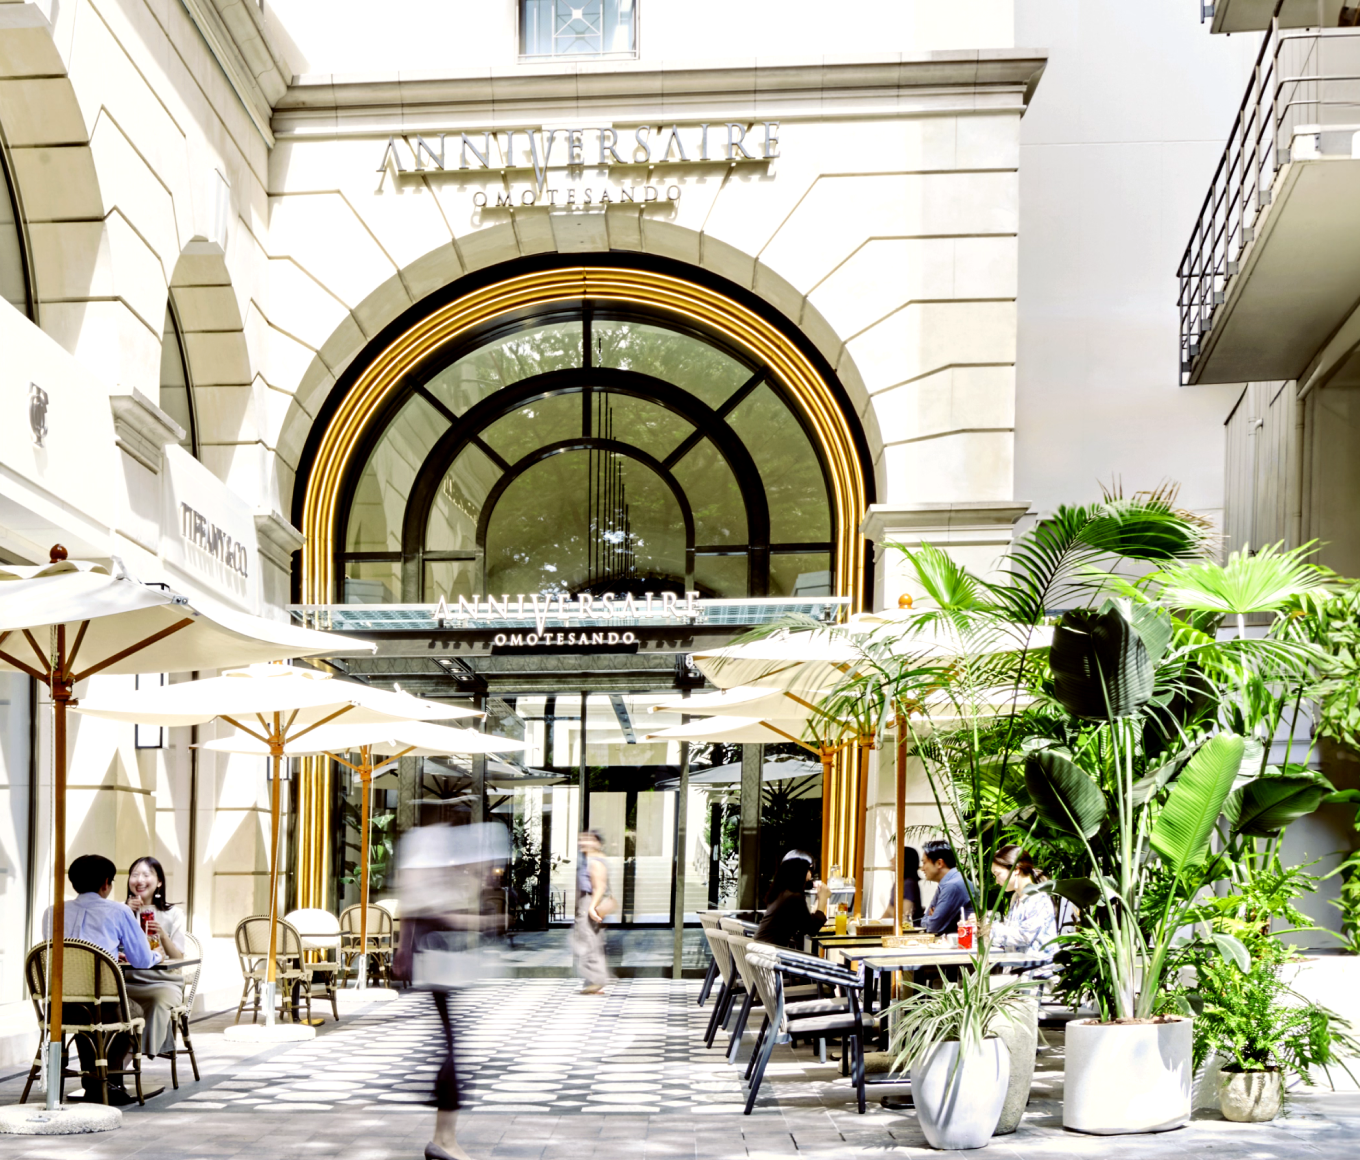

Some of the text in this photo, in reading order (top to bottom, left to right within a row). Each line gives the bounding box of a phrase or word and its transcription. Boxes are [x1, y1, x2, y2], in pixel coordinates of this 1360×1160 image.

[376, 121, 781, 192] ANNIVERSAIRE
[473, 185, 682, 207] OMOTESANDO
[432, 591, 700, 637] ANNIVERSAIRE
[494, 632, 636, 646] OMOTESANDO
